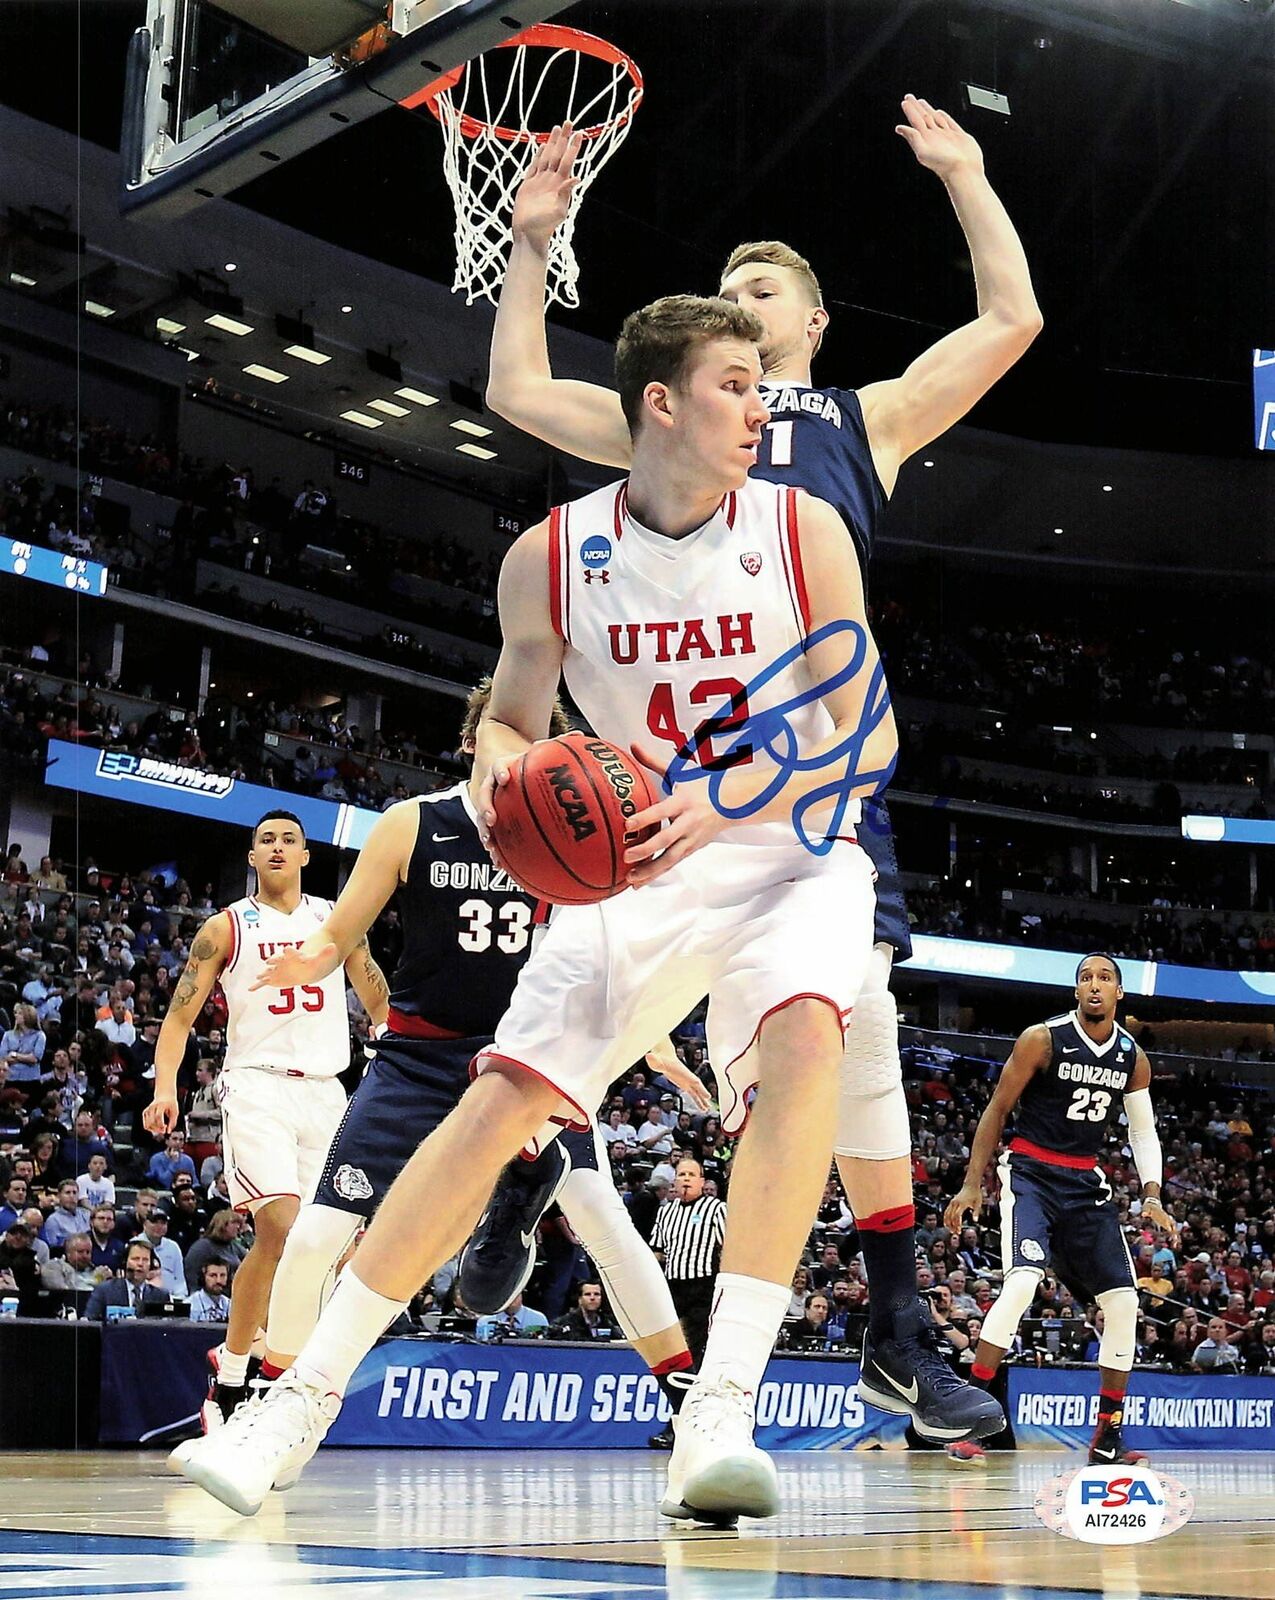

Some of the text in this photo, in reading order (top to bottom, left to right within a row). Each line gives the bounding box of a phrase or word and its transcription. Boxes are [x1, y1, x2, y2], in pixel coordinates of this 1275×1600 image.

[760, 389, 842, 429] ZAGA
[340, 462, 364, 479] 346
[498, 516, 519, 533] 348
[608, 612, 756, 664] UTAH
[646, 676, 754, 772] 42
[544, 763, 598, 842] NCAA
[429, 861, 525, 893] GONZA
[457, 899, 532, 954] 33
[1057, 1061, 1128, 1090] GONZAGA
[1066, 1087, 1112, 1122] 23
[376, 1365, 500, 1420] FIRST
[501, 1371, 583, 1423] AND
[756, 1381, 866, 1429] OUNDS
[1016, 1392, 1274, 1428] HOSTED B HE MOUNTAIN WEST
